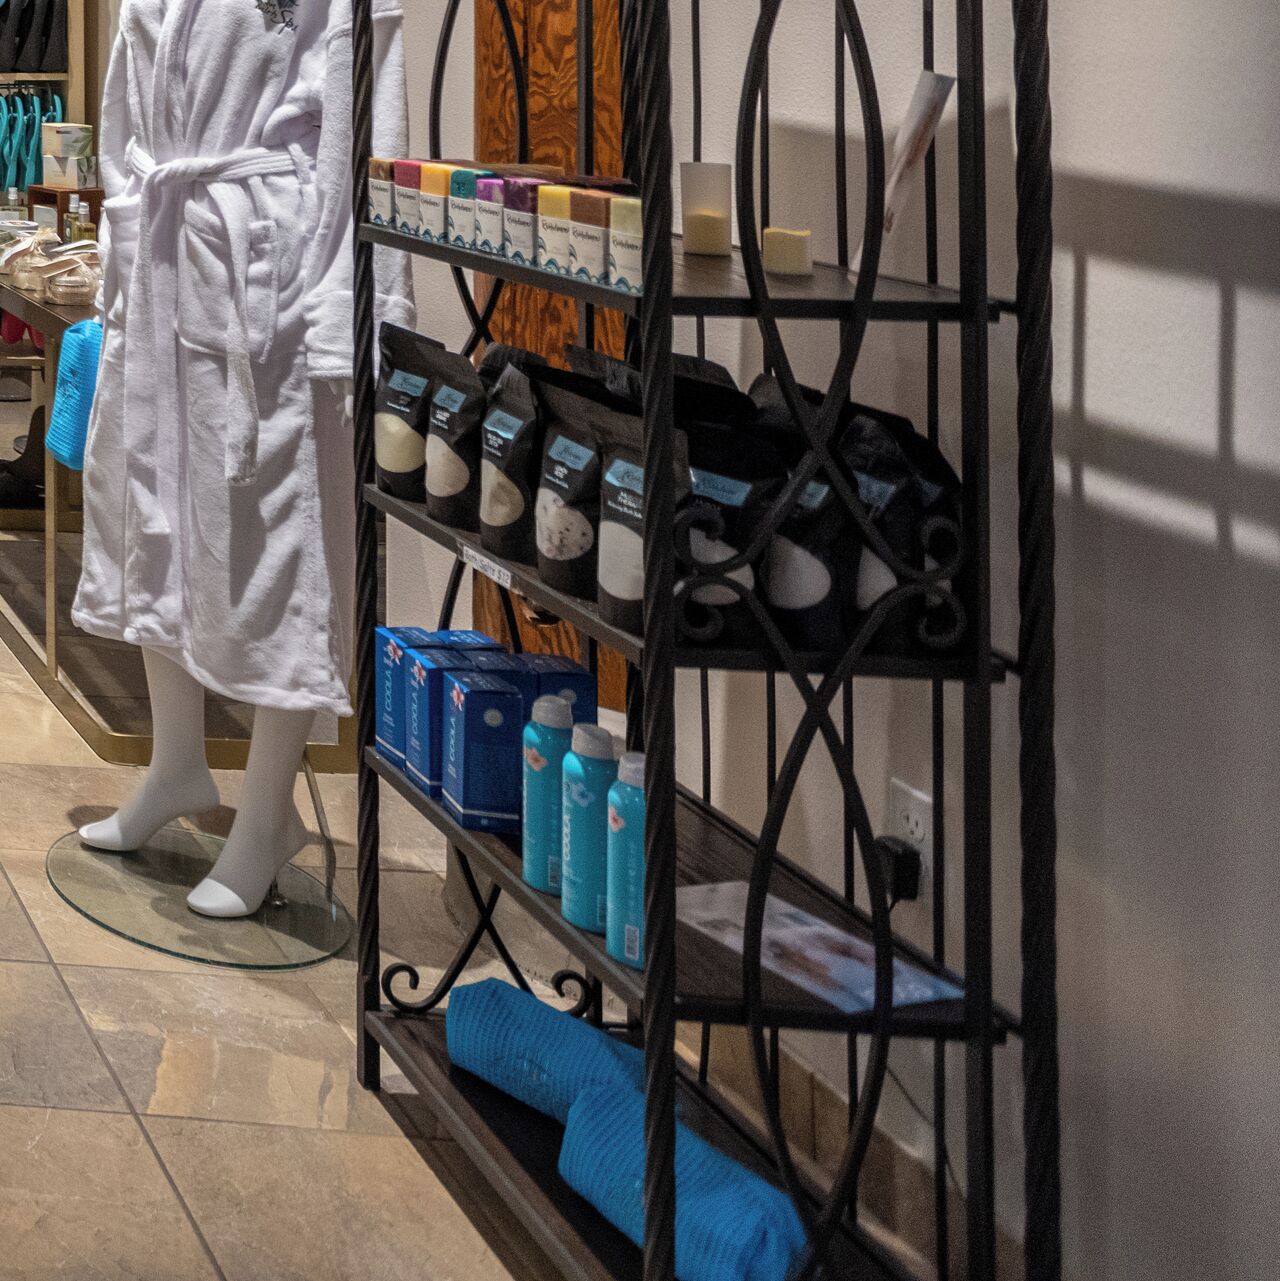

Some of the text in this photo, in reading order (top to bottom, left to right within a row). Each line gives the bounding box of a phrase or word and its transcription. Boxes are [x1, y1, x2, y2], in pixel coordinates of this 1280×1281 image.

[384, 670, 393, 712] COOLA
[411, 692, 419, 736] COOLA
[448, 716, 456, 763] COOLA
